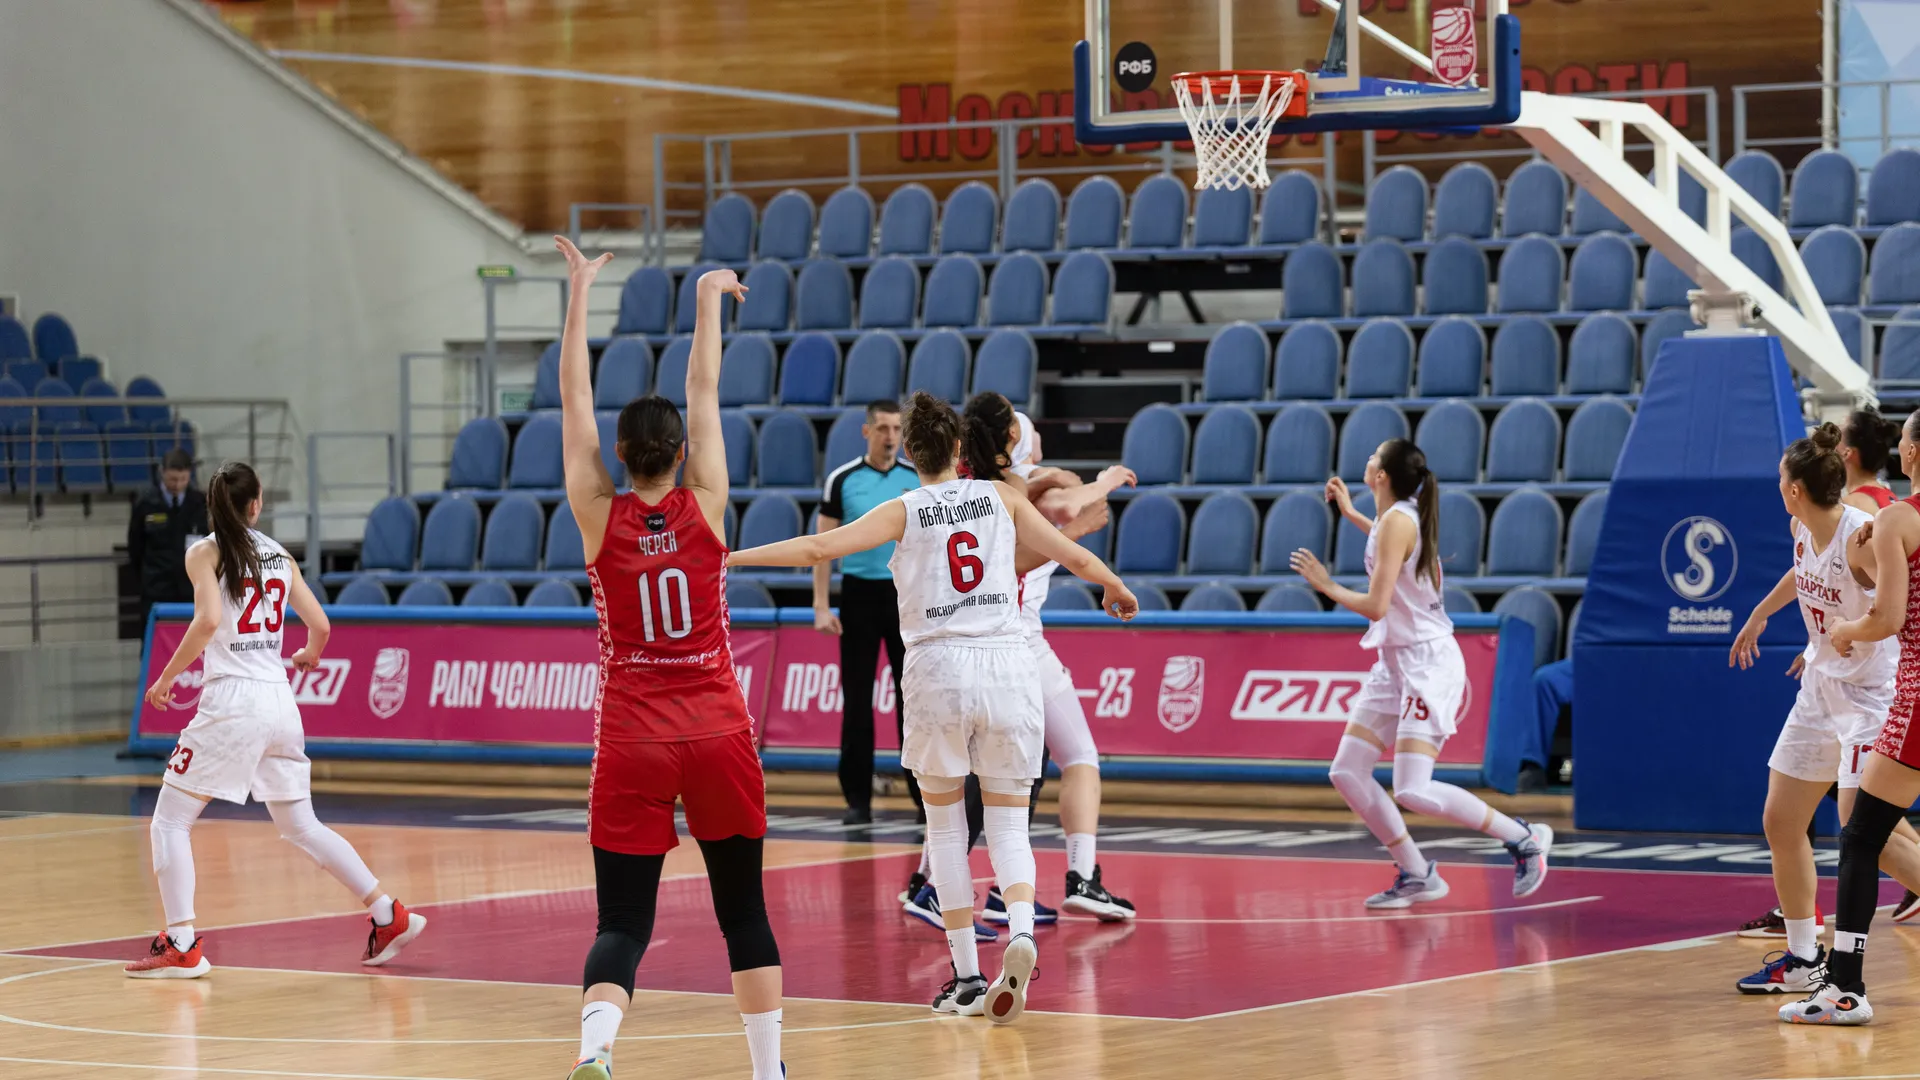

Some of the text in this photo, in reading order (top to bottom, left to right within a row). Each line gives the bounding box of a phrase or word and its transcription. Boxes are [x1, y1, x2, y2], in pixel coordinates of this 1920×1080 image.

[1119, 60, 1152, 75] РФБ
[946, 530, 984, 593] 6
[237, 578, 286, 634] 23
[638, 568, 693, 642] 10
[1668, 606, 1733, 623] Schelde
[428, 659, 488, 708] PARI
[1239, 678, 1364, 714] PAR
